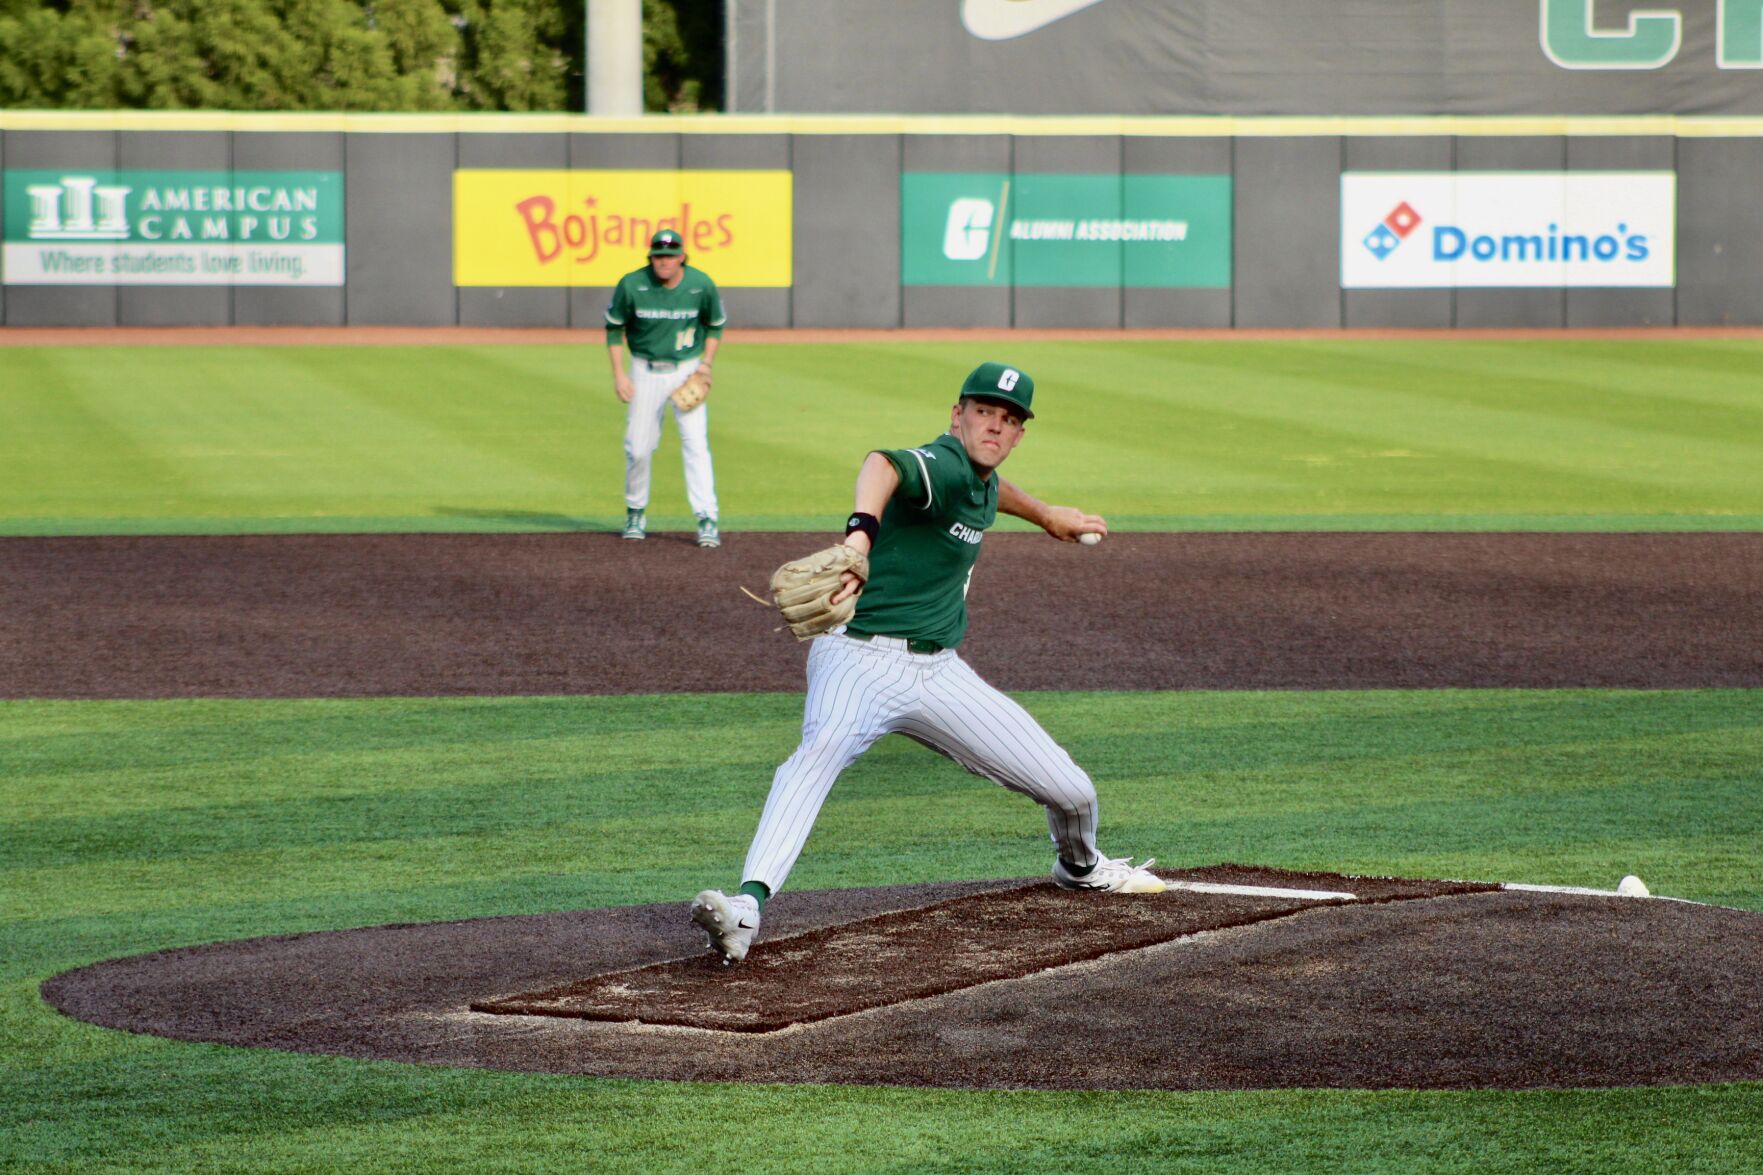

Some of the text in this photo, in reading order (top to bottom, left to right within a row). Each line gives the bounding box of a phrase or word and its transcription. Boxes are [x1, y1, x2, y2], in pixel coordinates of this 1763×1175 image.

[140, 187, 318, 211] AMERICAN
[138, 216, 318, 239] CAMPUS
[1010, 219, 1188, 241] ALUMNI ASSOCIATION
[1432, 223, 1649, 262] Domino's
[40, 250, 105, 273] Where
[111, 251, 195, 273] students
[202, 251, 242, 273] love
